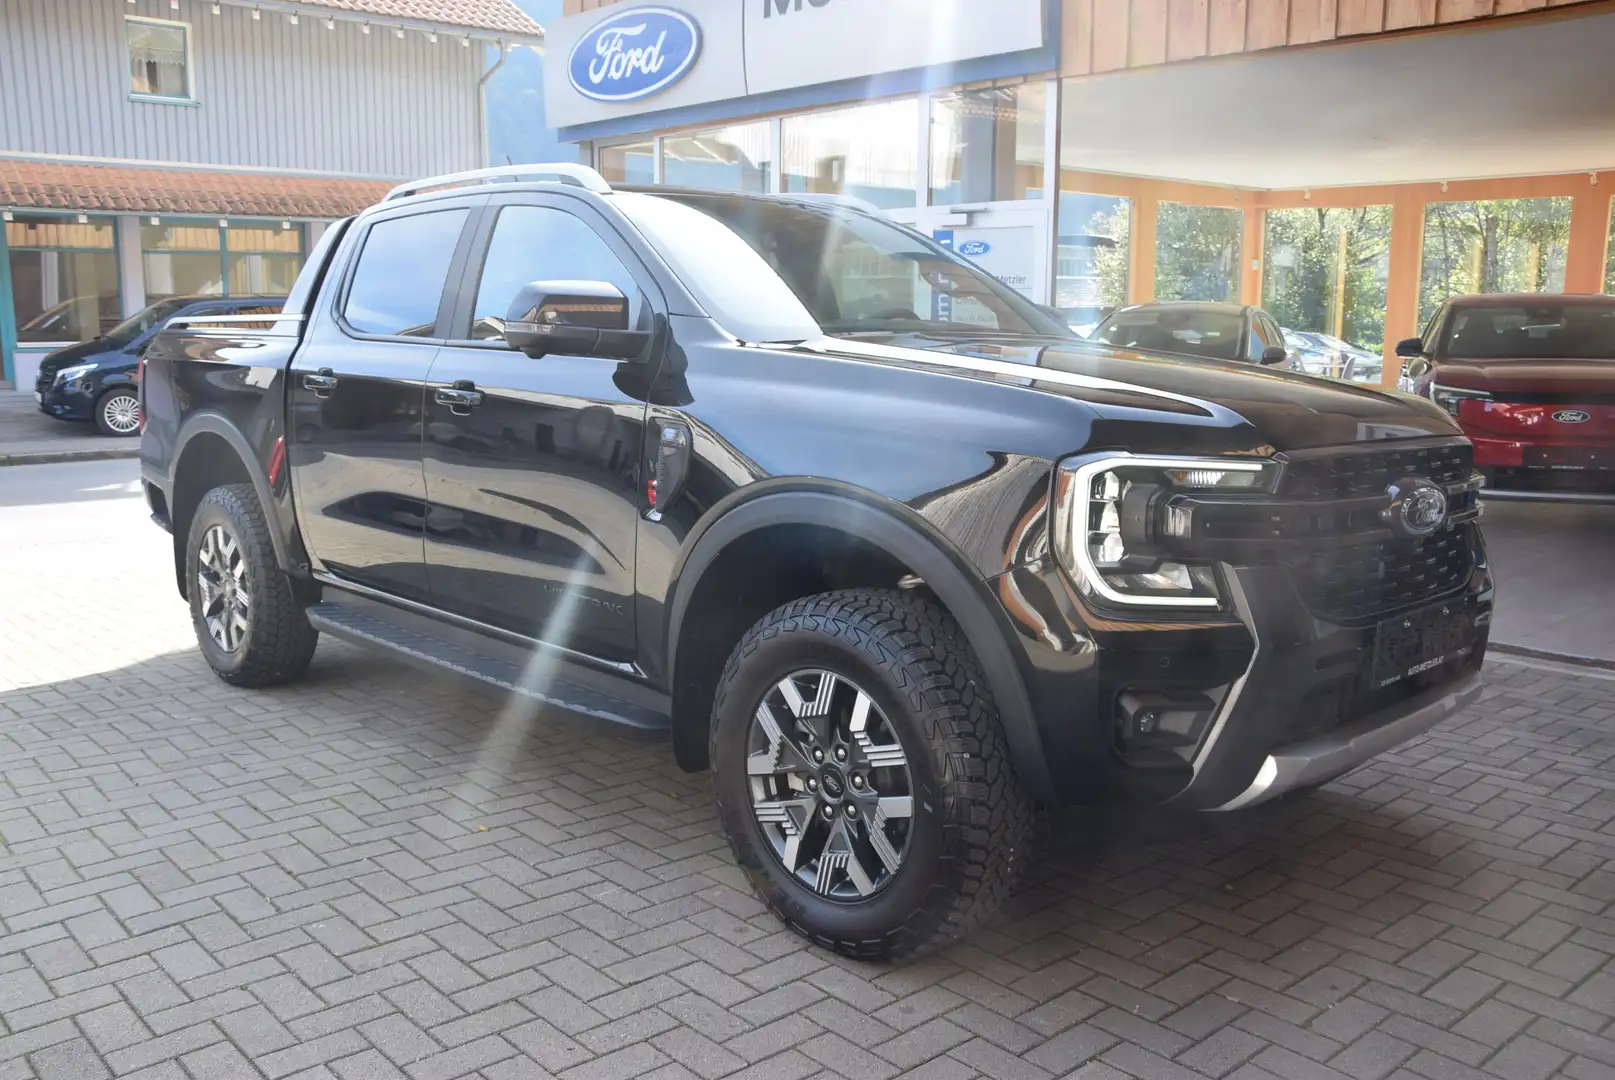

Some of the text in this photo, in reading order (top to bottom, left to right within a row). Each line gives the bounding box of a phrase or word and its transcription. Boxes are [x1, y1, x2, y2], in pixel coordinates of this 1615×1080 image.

[588, 22, 668, 85] Ford
[963, 242, 985, 254] Ford
[1558, 411, 1583, 421] Ford
